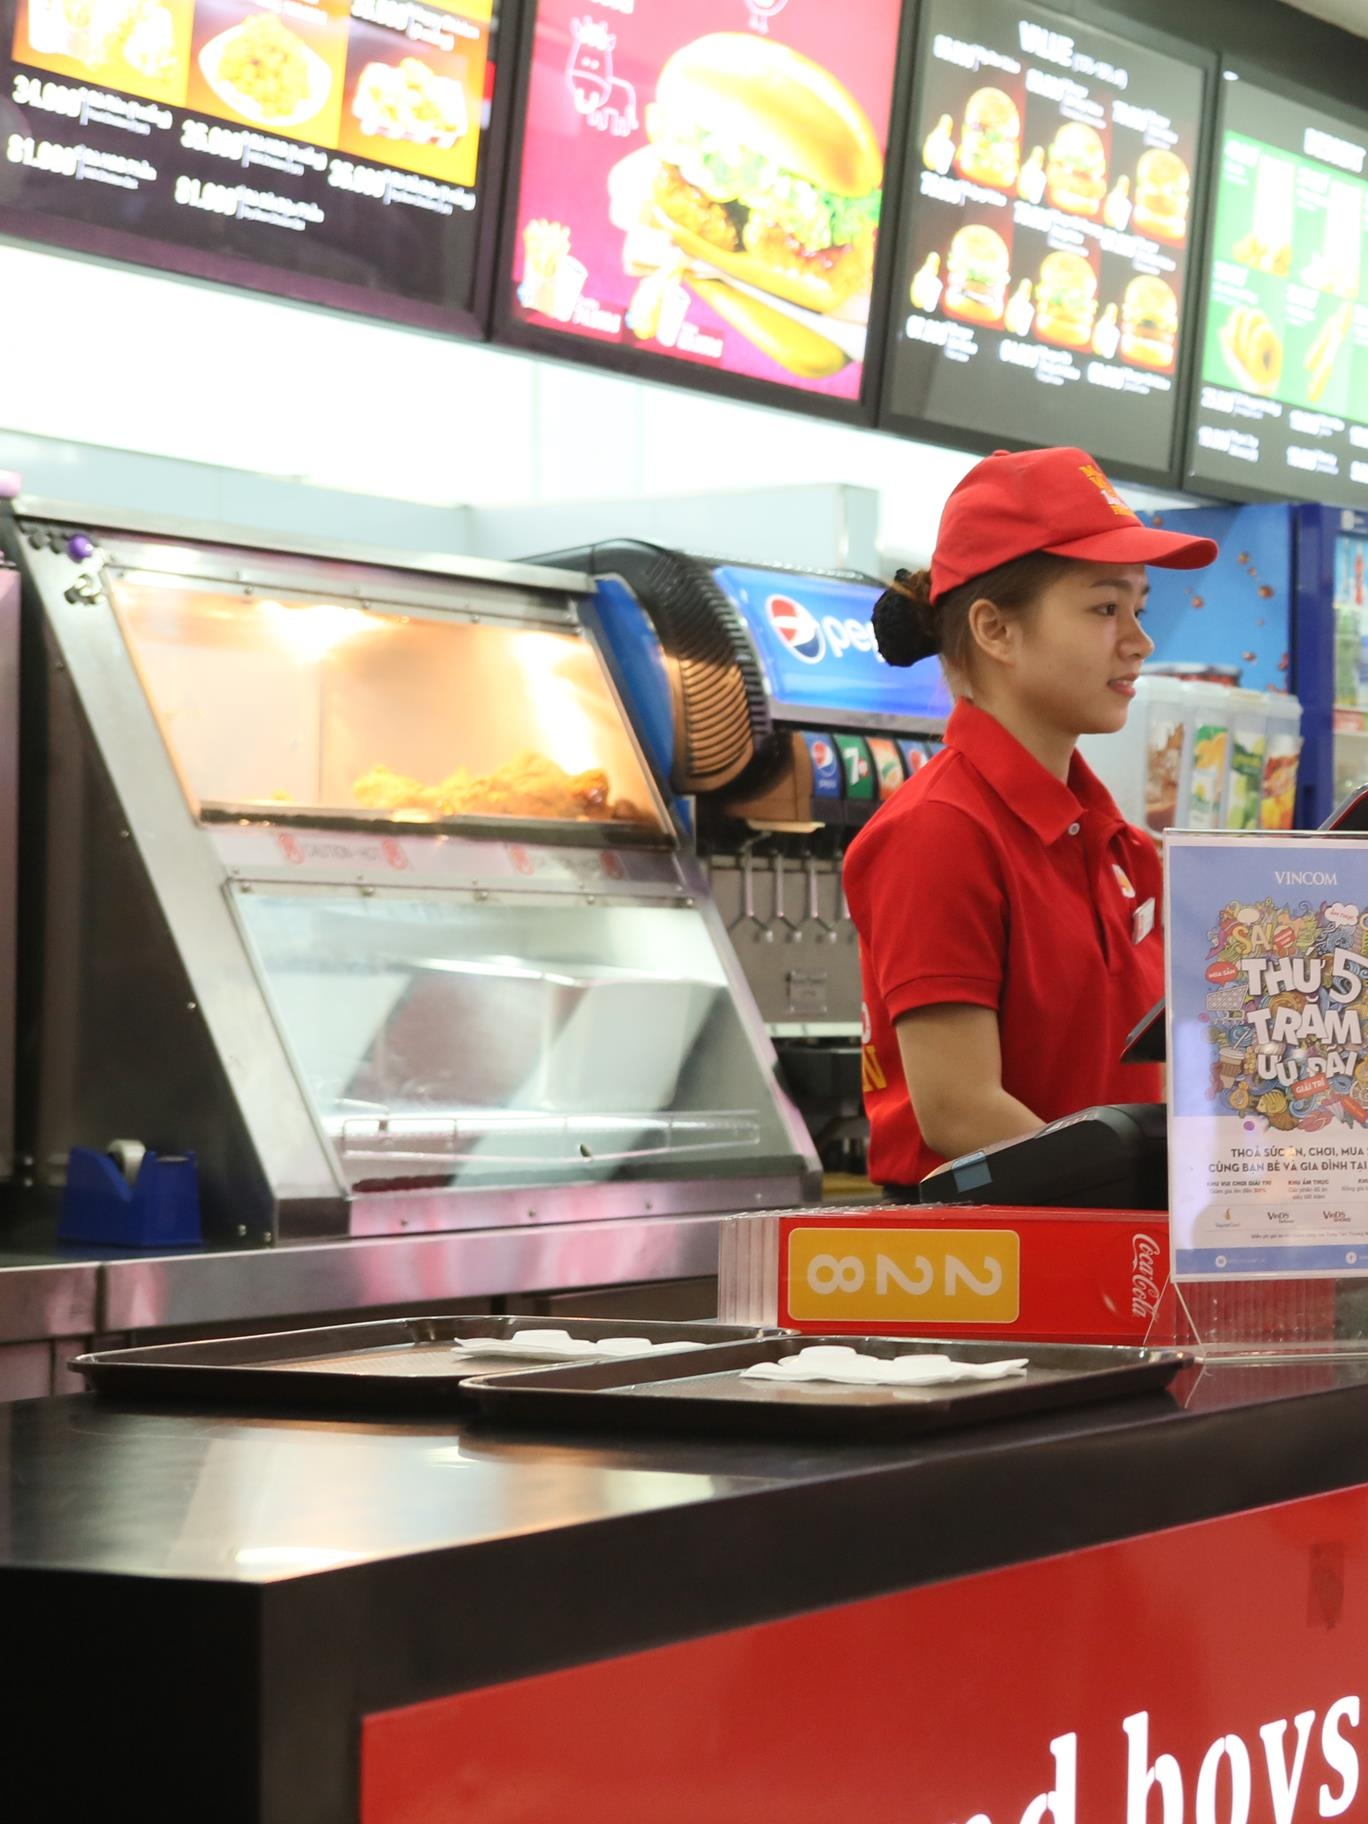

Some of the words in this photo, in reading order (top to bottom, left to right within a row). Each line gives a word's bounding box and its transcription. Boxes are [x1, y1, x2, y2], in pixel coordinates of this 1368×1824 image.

[1275, 871, 1338, 886] VINCOM
[1241, 946, 1325, 996] THỨ
[1247, 994, 1362, 1045] TRĂM
[1264, 1144, 1286, 1157] SỨC
[1308, 1147, 1338, 1157] CHƠI,
[1341, 1147, 1365, 1156] MUA
[1300, 1161, 1319, 1171] GIA
[1321, 1159, 1348, 1170] ĐÌNH
